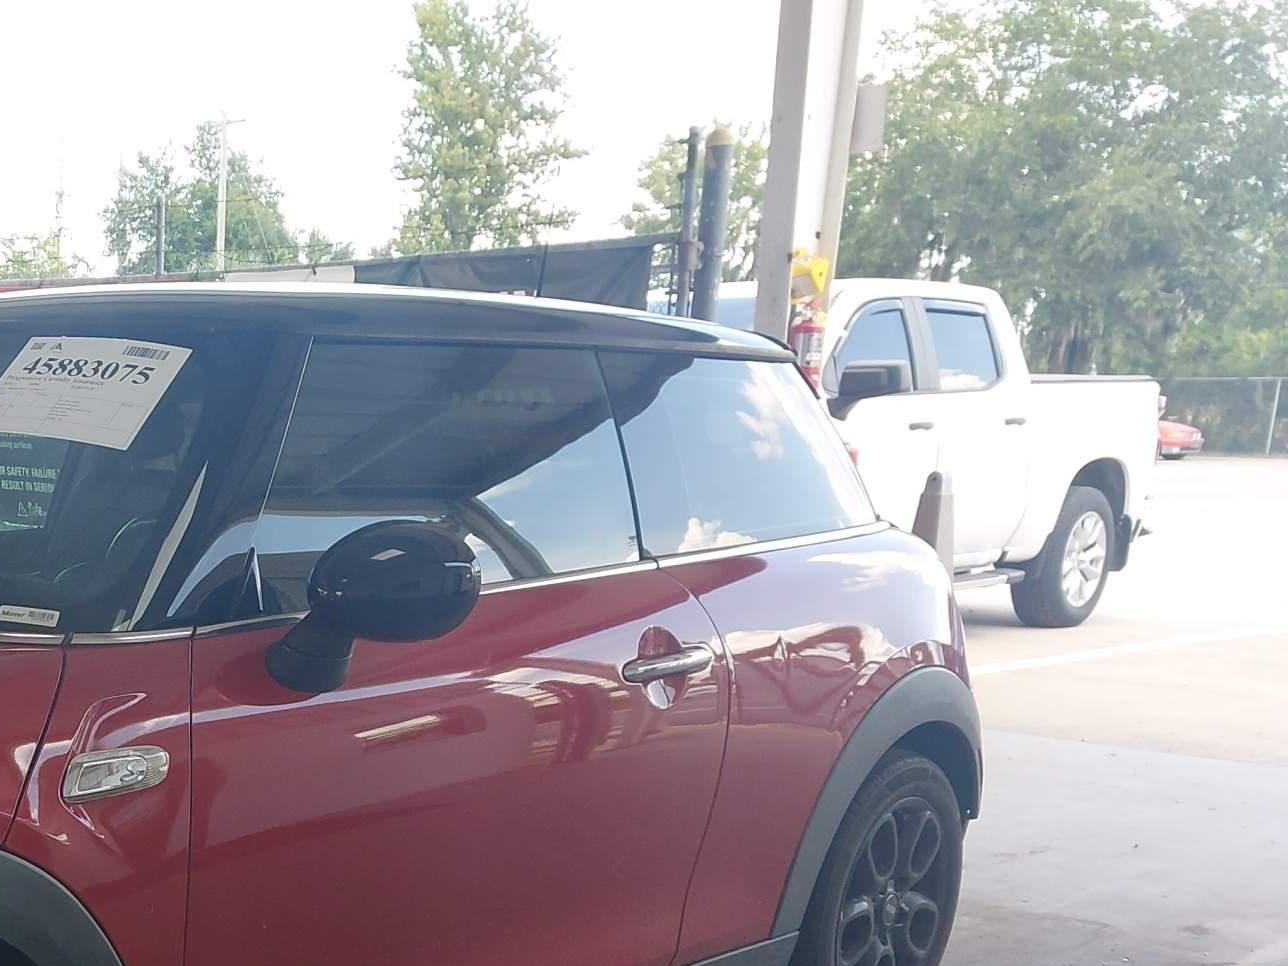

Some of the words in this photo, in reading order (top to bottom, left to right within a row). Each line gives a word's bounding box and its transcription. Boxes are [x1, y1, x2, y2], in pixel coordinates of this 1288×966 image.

[23, 356, 156, 385] 45883075
[31, 467, 57, 479] FAILURE
[1, 479, 25, 491] RESULT
[25, 481, 33, 491] IN
[33, 481, 56, 493] SERIO
